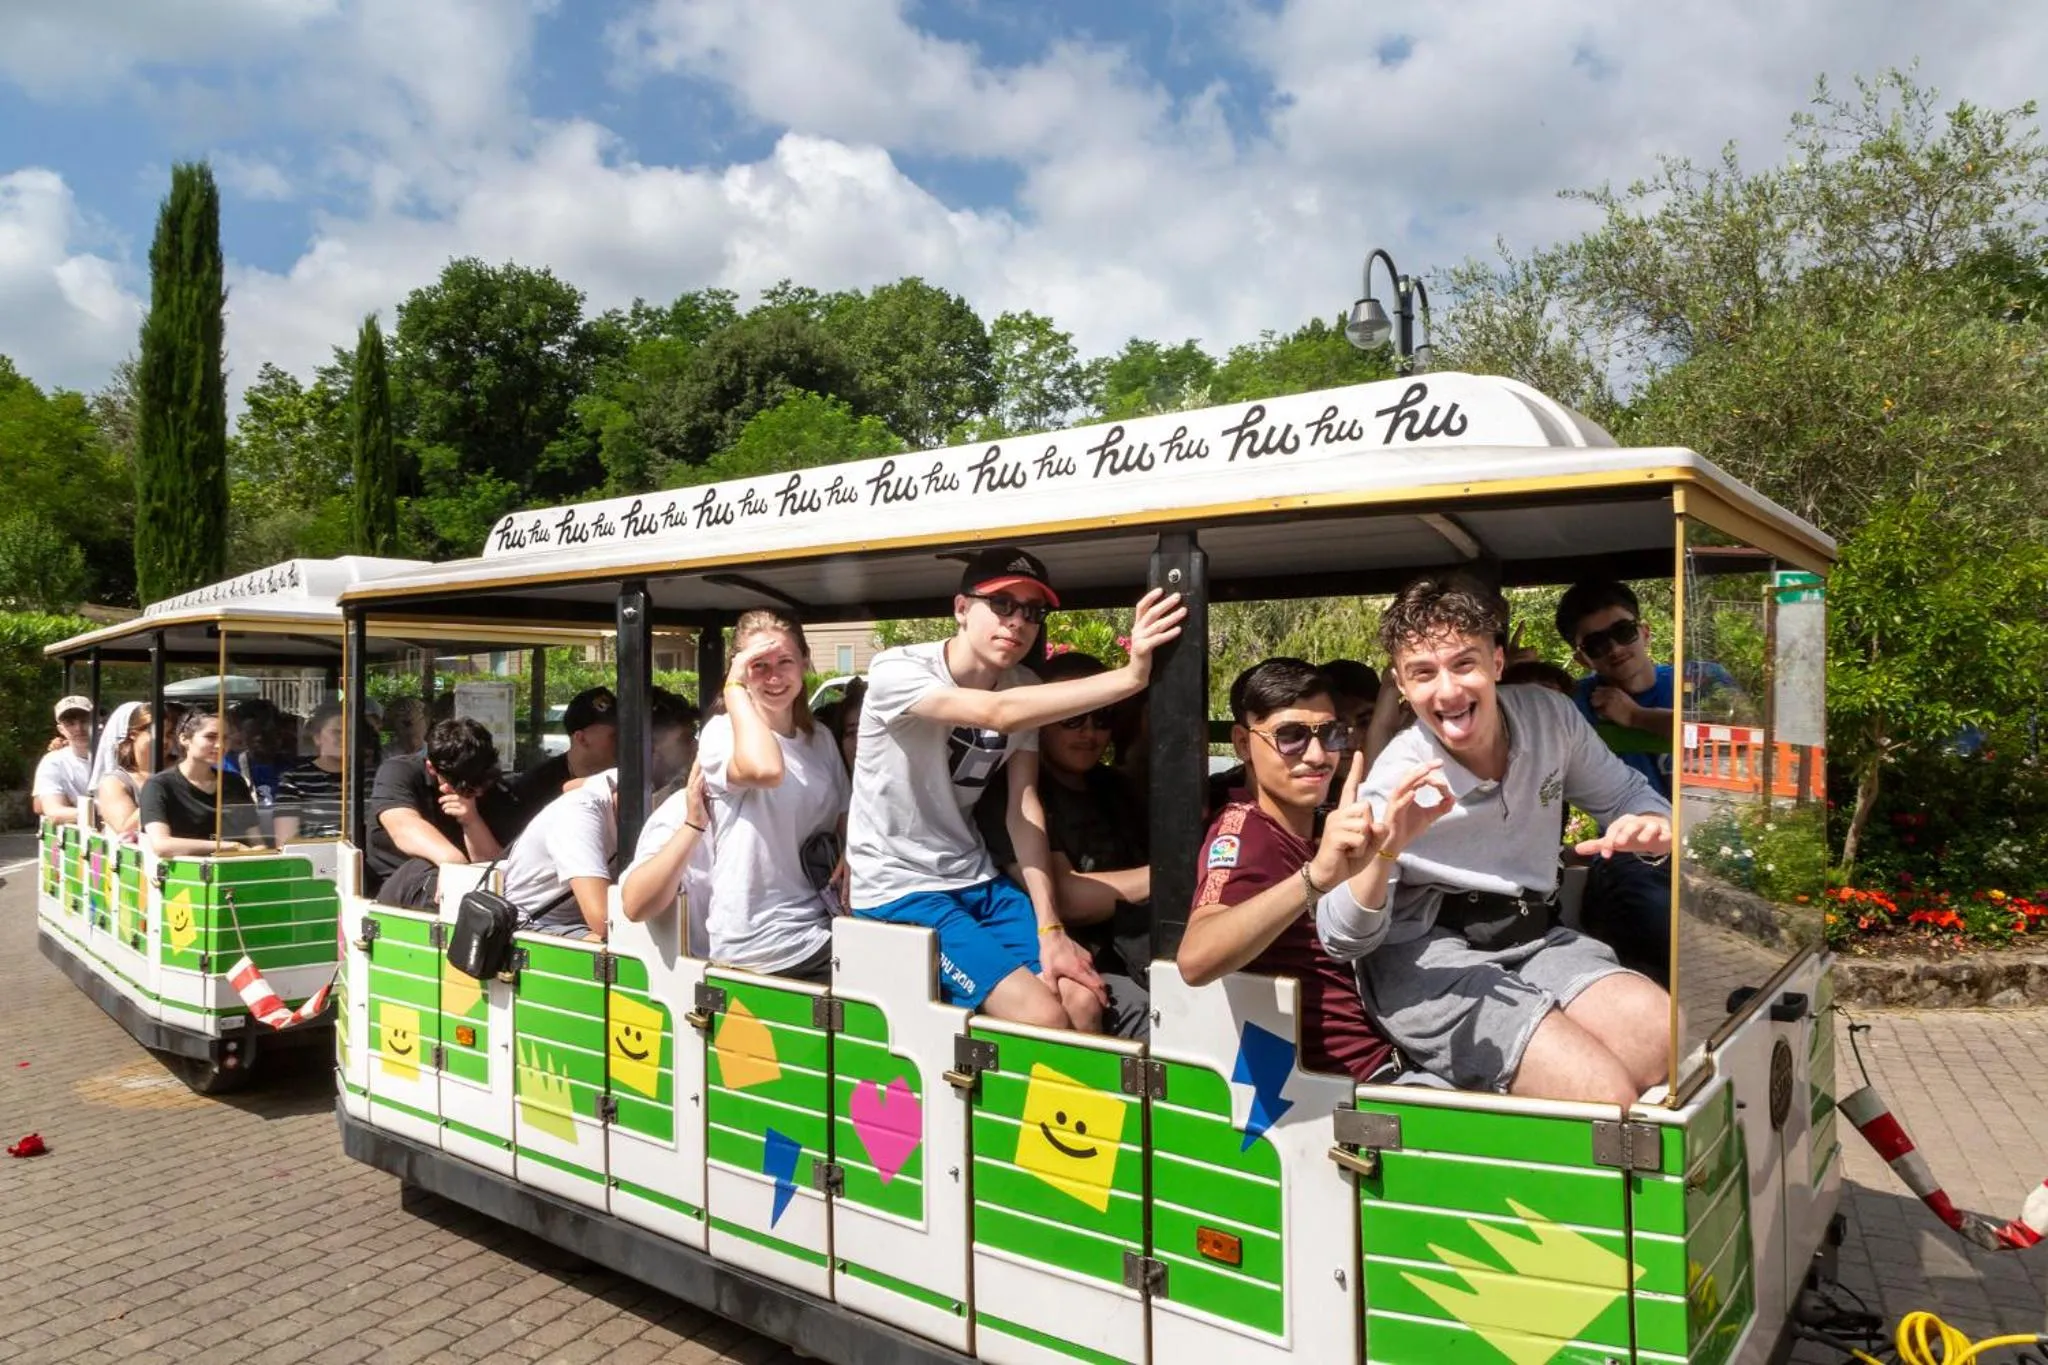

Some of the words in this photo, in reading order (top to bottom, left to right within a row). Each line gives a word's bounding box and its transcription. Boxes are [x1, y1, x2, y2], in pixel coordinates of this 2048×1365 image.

[495, 516, 526, 551] hu
[528, 519, 550, 544] hu
[555, 509, 589, 545] hu
[591, 513, 615, 538] hu
[621, 499, 658, 538] hu
[660, 502, 687, 528] hu
[693, 488, 734, 529] hu
[738, 488, 768, 516] hu
[775, 473, 821, 517] hu
[824, 476, 858, 506] hu
[866, 460, 918, 506] hu
[921, 462, 959, 494] hu
[967, 445, 1026, 493] hu
[1033, 445, 1076, 480] hu
[1087, 426, 1155, 478] hu
[1160, 426, 1209, 463] hu
[1222, 405, 1300, 462] hu
[1306, 405, 1363, 446] hu
[1375, 383, 1467, 445] hu
